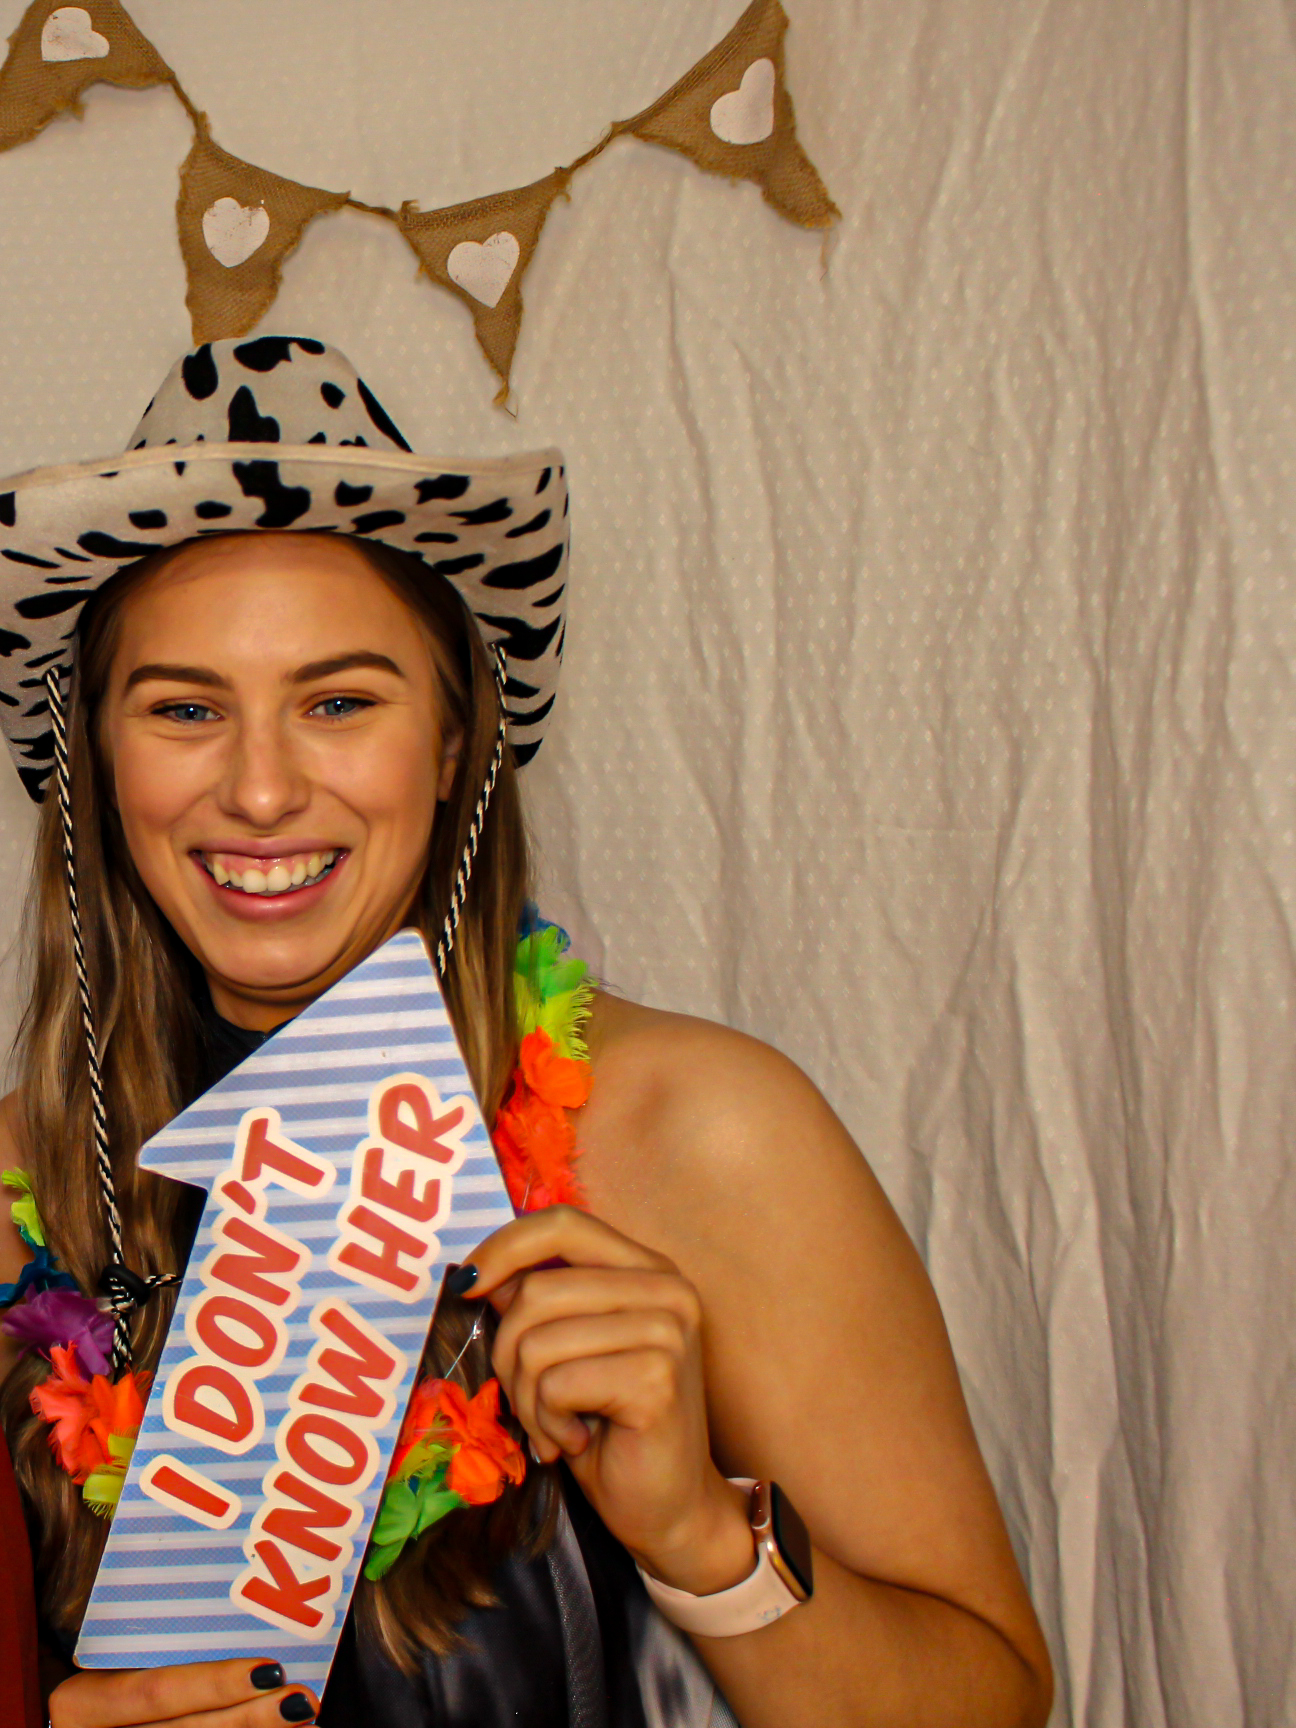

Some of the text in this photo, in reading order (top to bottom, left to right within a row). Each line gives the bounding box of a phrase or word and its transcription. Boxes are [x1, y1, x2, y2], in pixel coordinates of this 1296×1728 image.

[145, 1113, 331, 1523] I DON'T
[236, 1078, 468, 1634] KNOW HER
